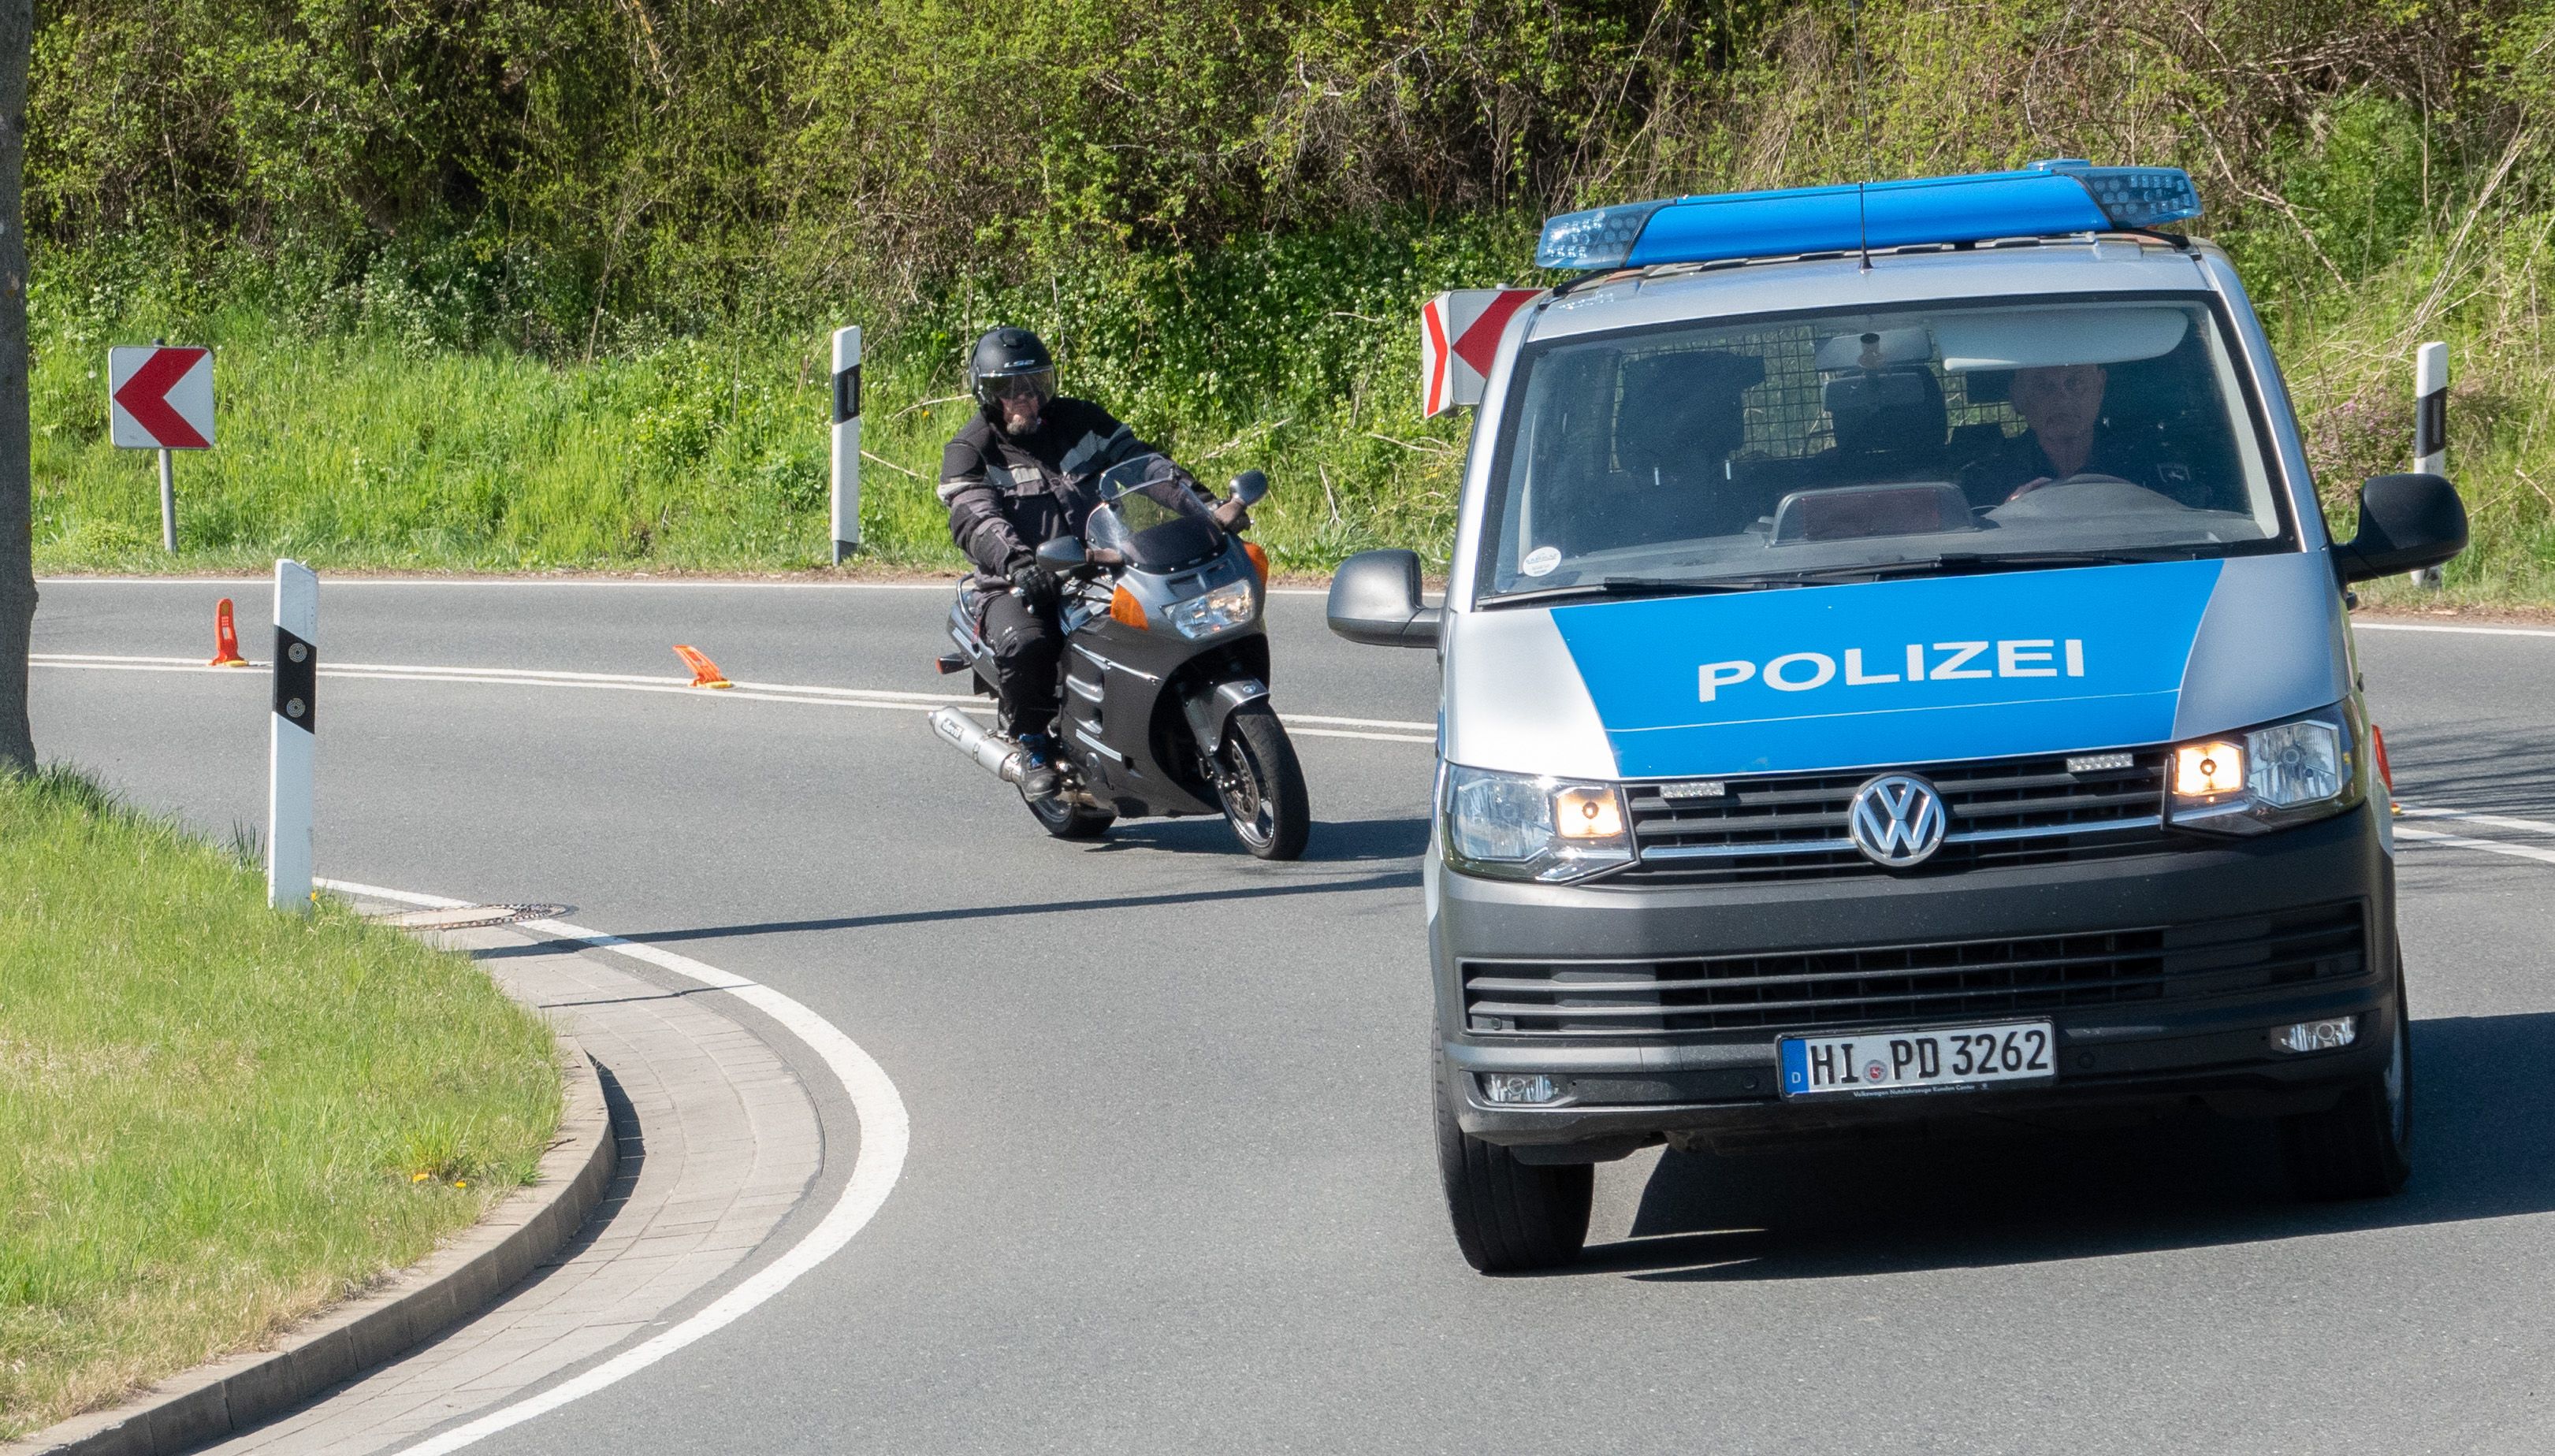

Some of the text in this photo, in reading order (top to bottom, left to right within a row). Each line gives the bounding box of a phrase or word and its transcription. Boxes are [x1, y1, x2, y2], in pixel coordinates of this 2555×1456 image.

[1003, 359, 1036, 368] LS2
[1698, 639, 2084, 703] POLIZEI
[1852, 776, 1946, 862] VW
[1791, 1072, 1801, 1084] D
[1810, 1030, 2048, 1086] HI PD 3262
